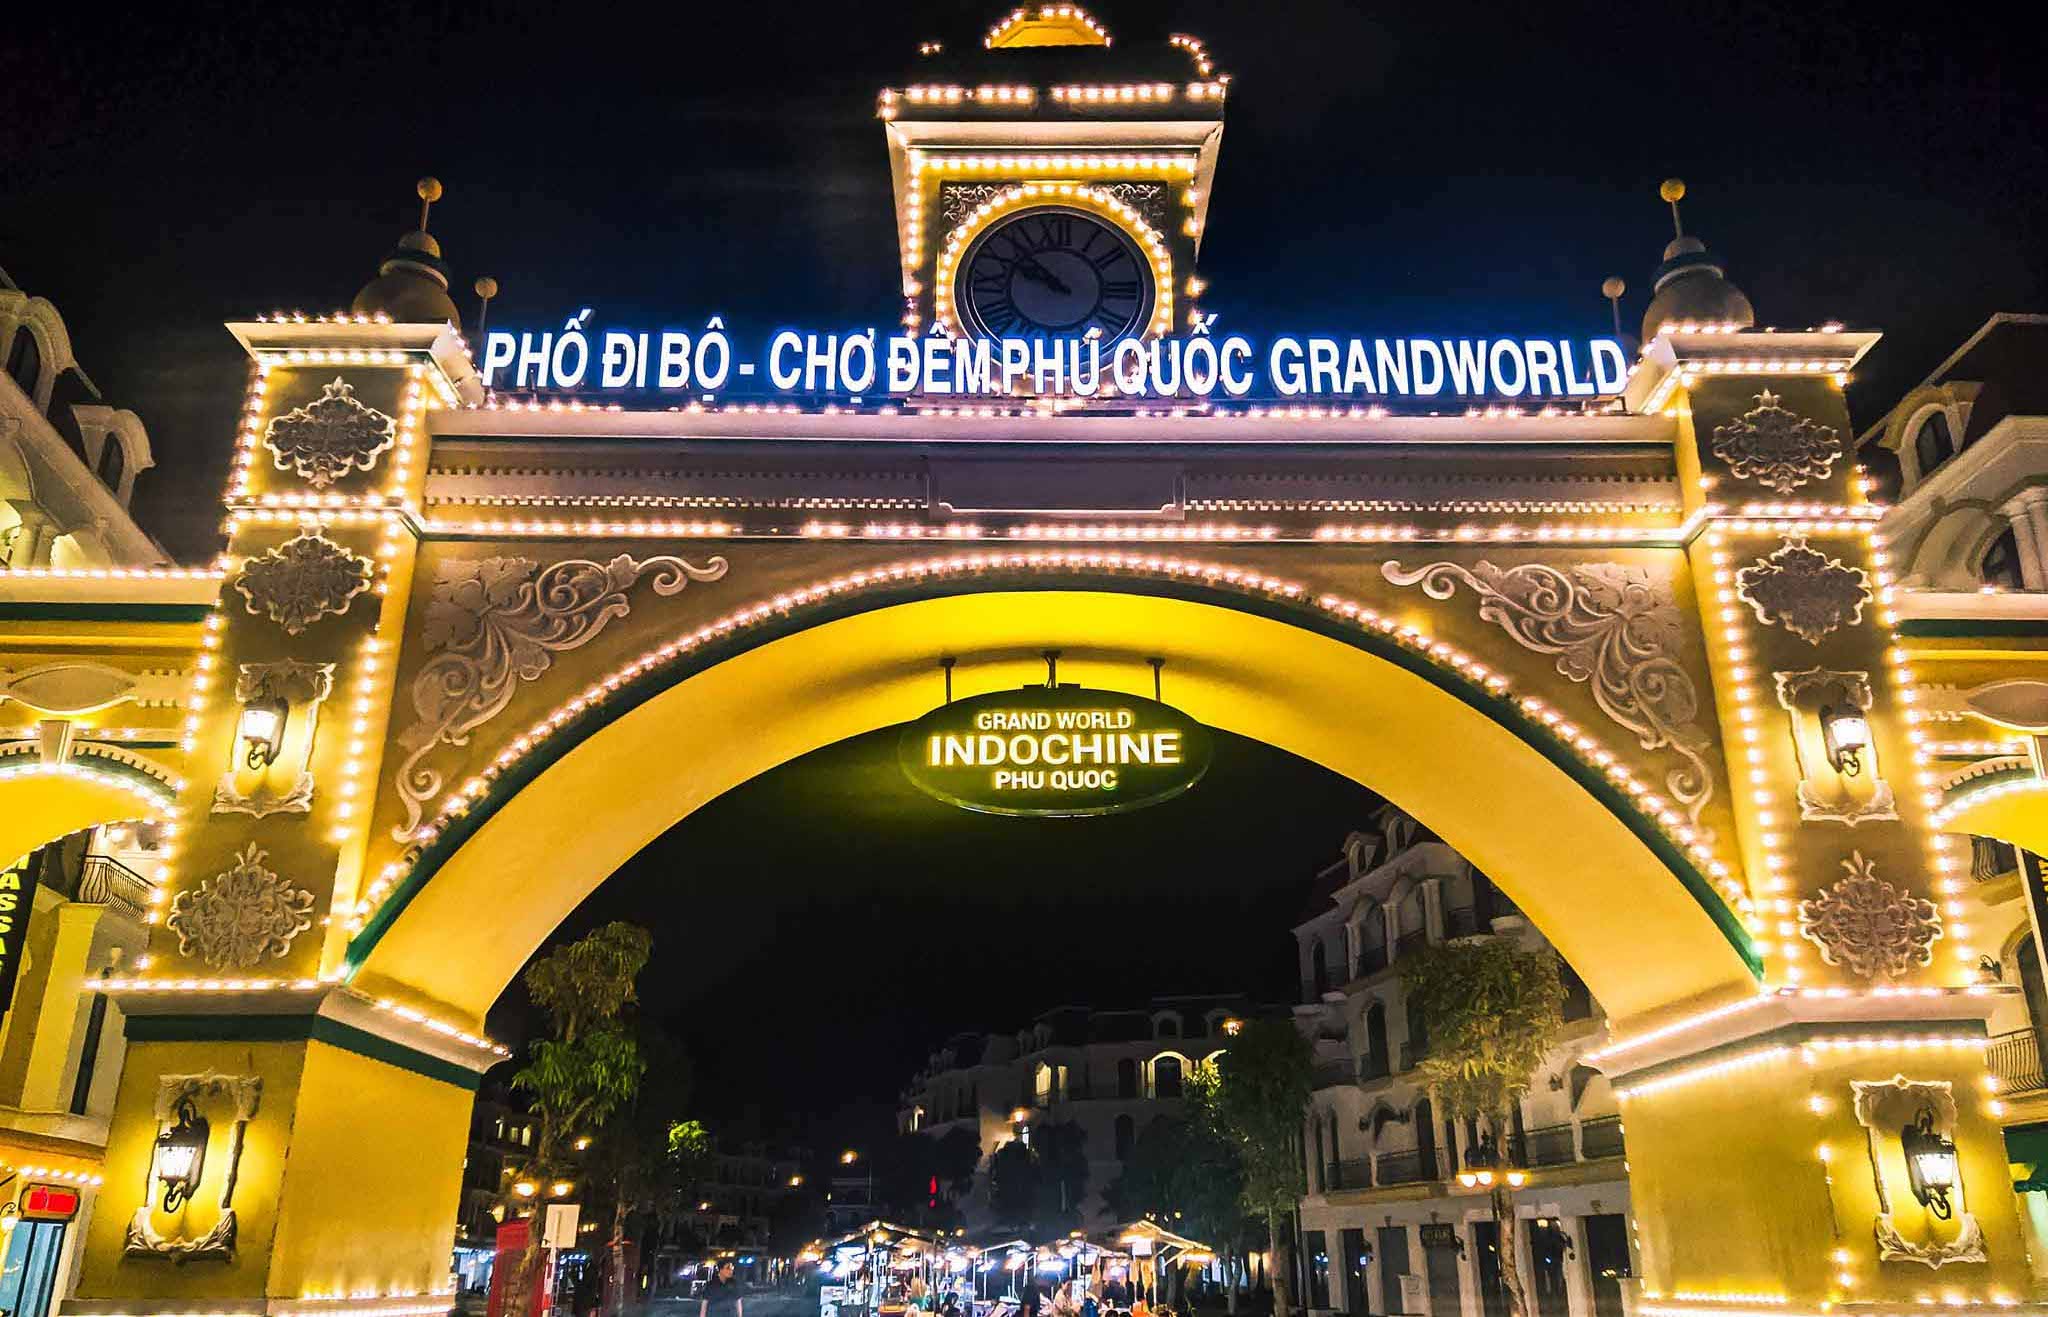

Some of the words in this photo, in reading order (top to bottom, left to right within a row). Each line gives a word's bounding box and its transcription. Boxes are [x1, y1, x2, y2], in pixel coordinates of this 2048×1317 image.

[482, 309, 591, 388] PHỐ
[602, 332, 649, 388] ĐI
[659, 317, 730, 402] BỘ
[769, 328, 876, 404] CHỢ
[887, 322, 992, 394] ĐÊM
[1002, 326, 1102, 397] PHÚ
[1113, 313, 1254, 398] QUỐC
[1270, 337, 1628, 397] GRANDWORLD
[977, 711, 1051, 731] GRAND
[1057, 710, 1132, 730] WORLD
[930, 733, 1181, 766] INDOCHINE
[996, 770, 1044, 790] PHU
[1050, 770, 1118, 792] QUOC
